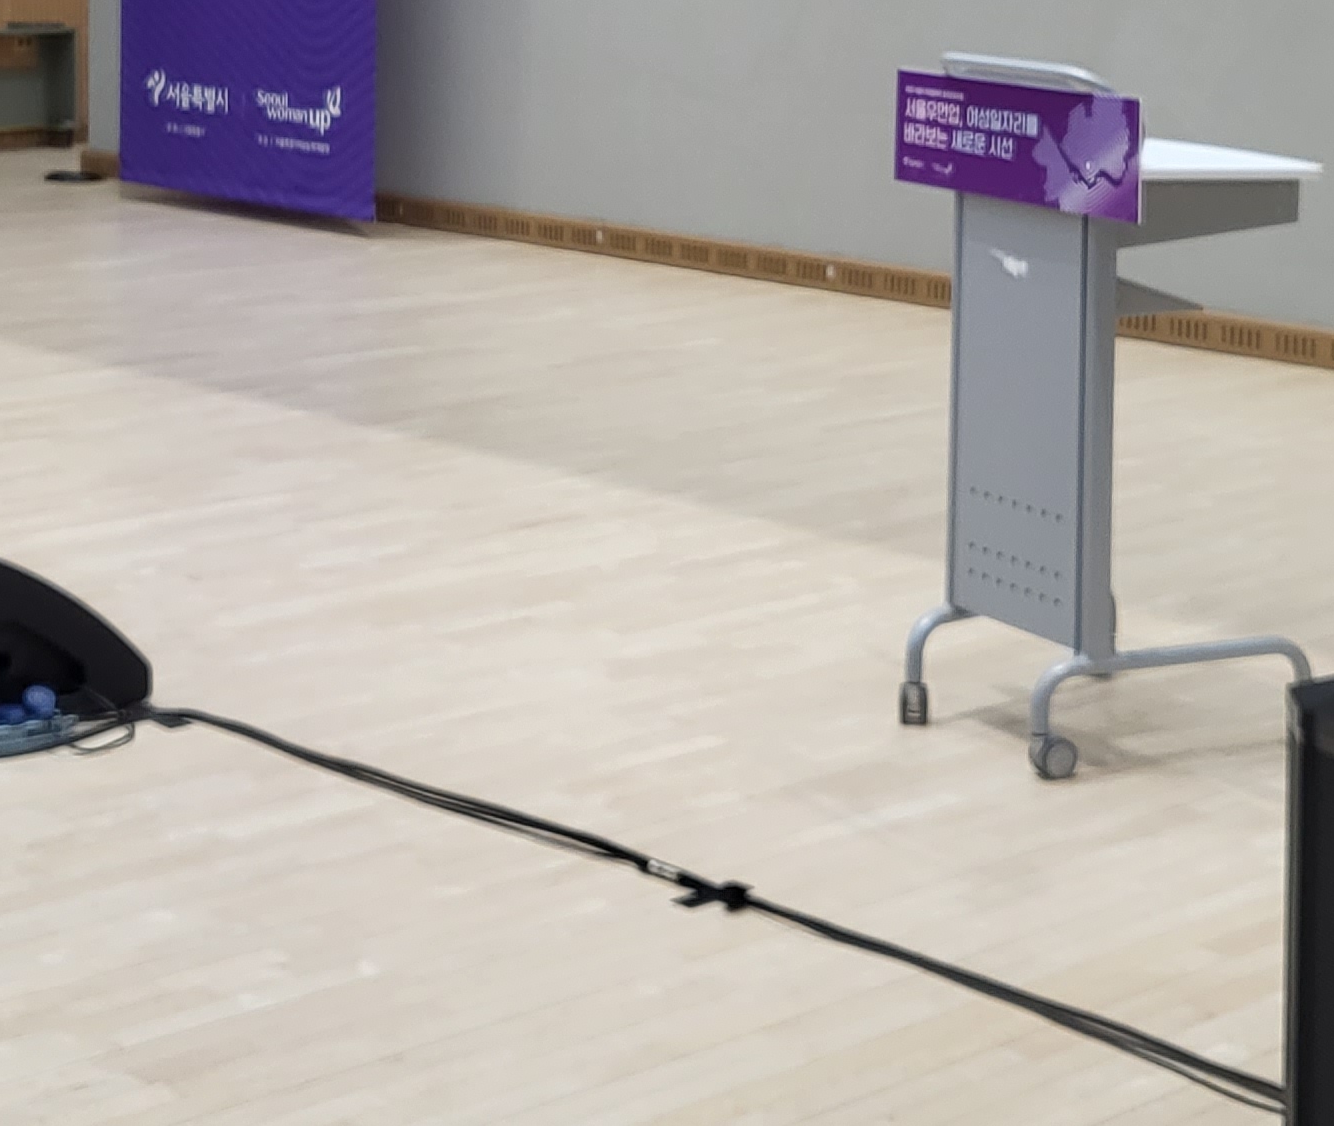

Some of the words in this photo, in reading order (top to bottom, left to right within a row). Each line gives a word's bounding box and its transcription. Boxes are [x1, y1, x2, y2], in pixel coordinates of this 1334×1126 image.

[167, 82, 229, 115] 서울특별시
[256, 88, 289, 107] Seoul
[309, 108, 331, 136] up
[904, 97, 963, 128] 서울우먼업,
[966, 105, 1039, 138] 여성일자리를
[903, 122, 948, 150] 바라보는
[951, 129, 986, 156] 새로운
[989, 136, 1013, 160] 시선
